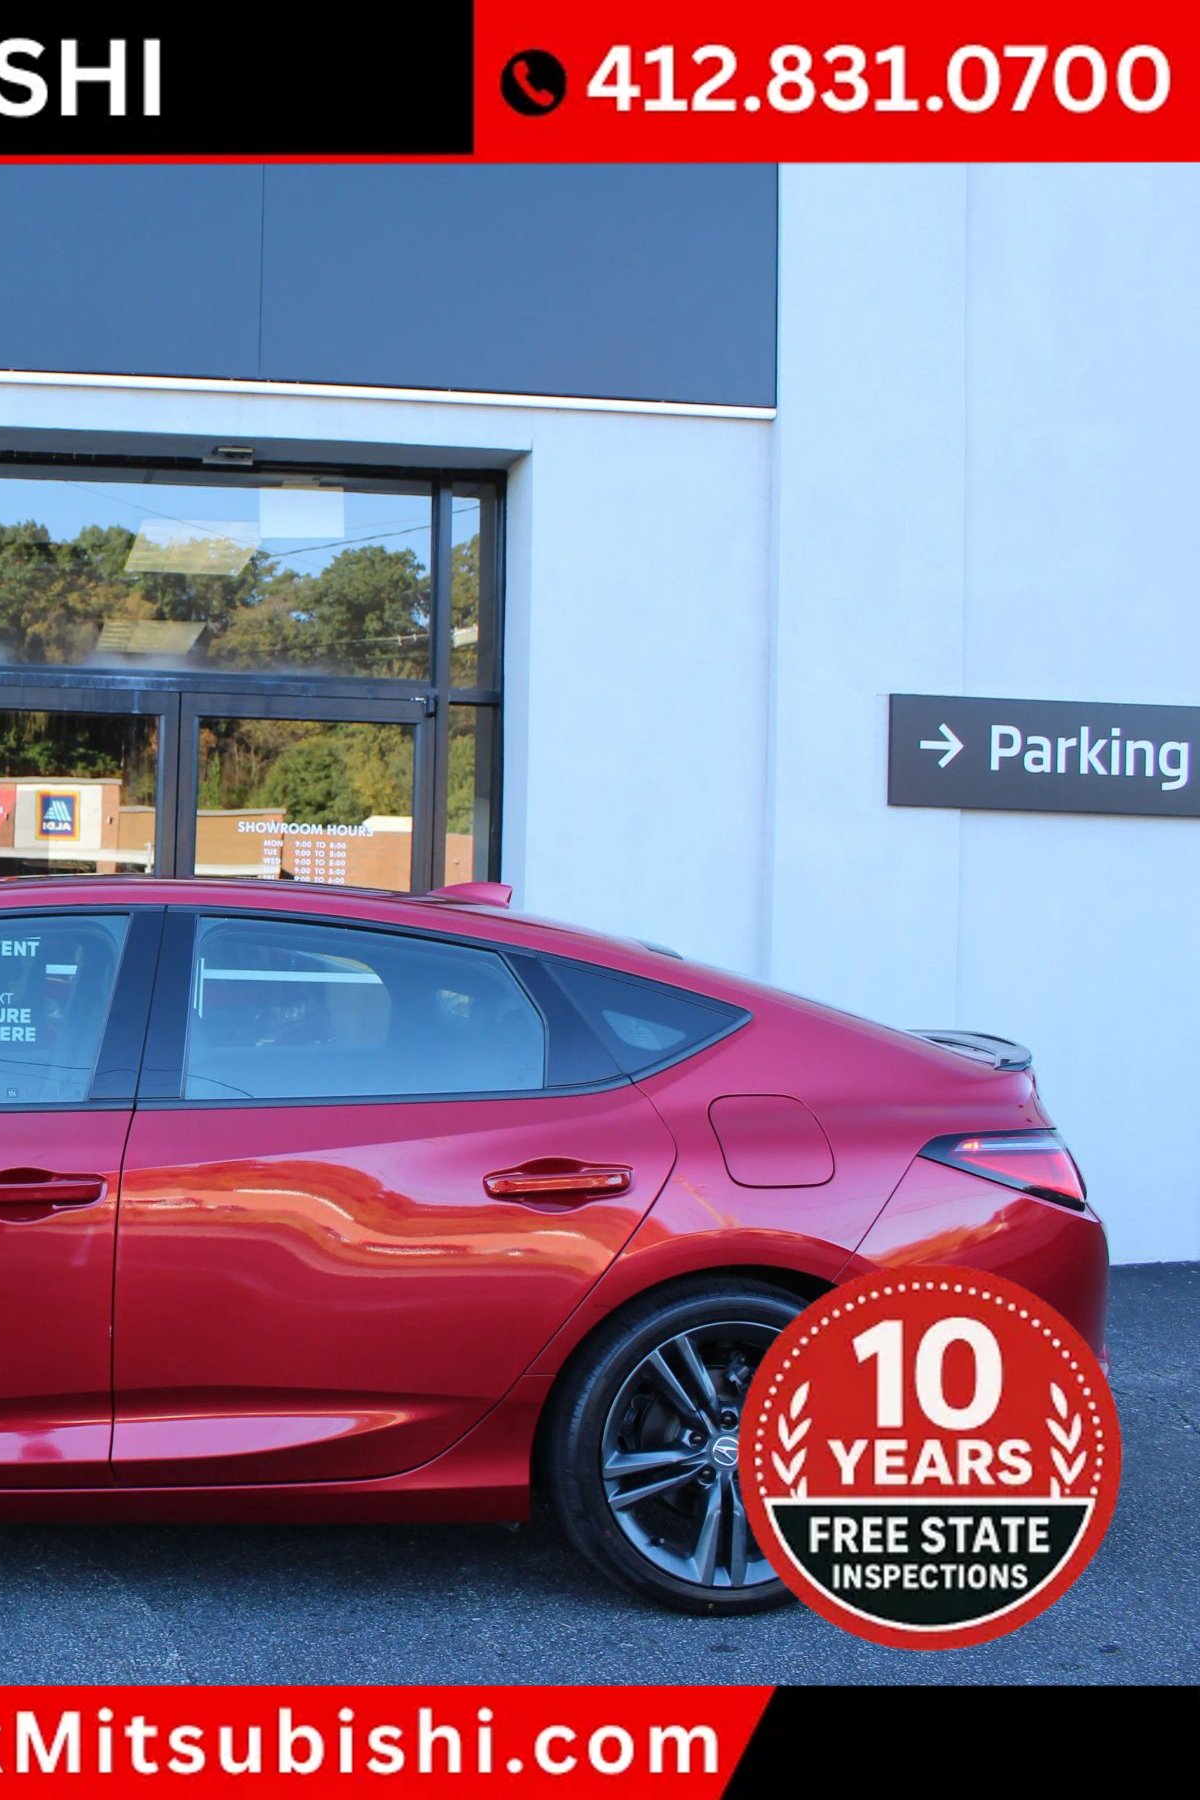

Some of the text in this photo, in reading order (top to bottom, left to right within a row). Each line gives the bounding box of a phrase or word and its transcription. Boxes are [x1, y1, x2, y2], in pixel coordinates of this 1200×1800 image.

[990, 725, 1190, 791] Parking
[238, 821, 374, 837] SHOWROOM HOURS
